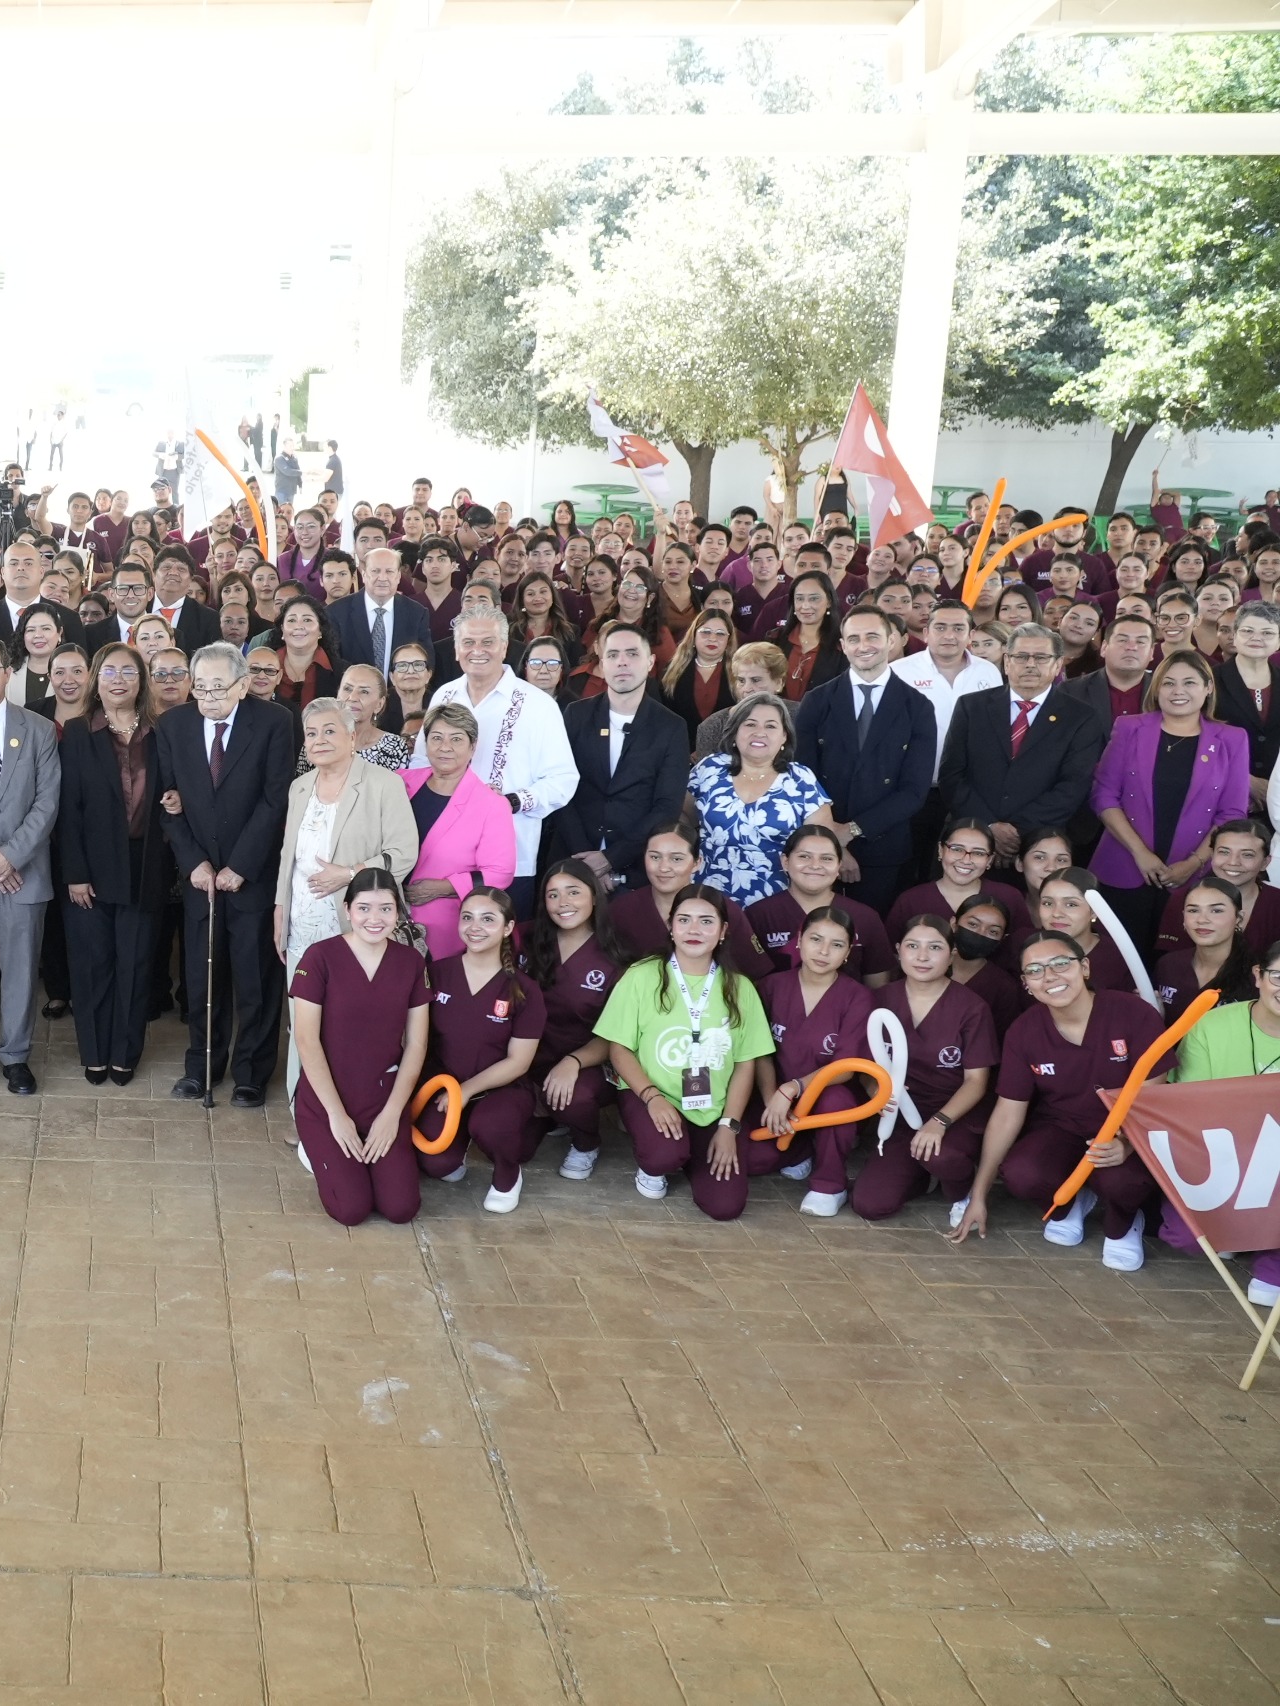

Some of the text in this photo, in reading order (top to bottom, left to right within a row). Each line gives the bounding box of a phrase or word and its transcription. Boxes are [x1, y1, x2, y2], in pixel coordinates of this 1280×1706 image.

[766, 931, 791, 943] UAT
[1030, 1063, 1055, 1076] UAT
[687, 1100, 707, 1109] STAFF
